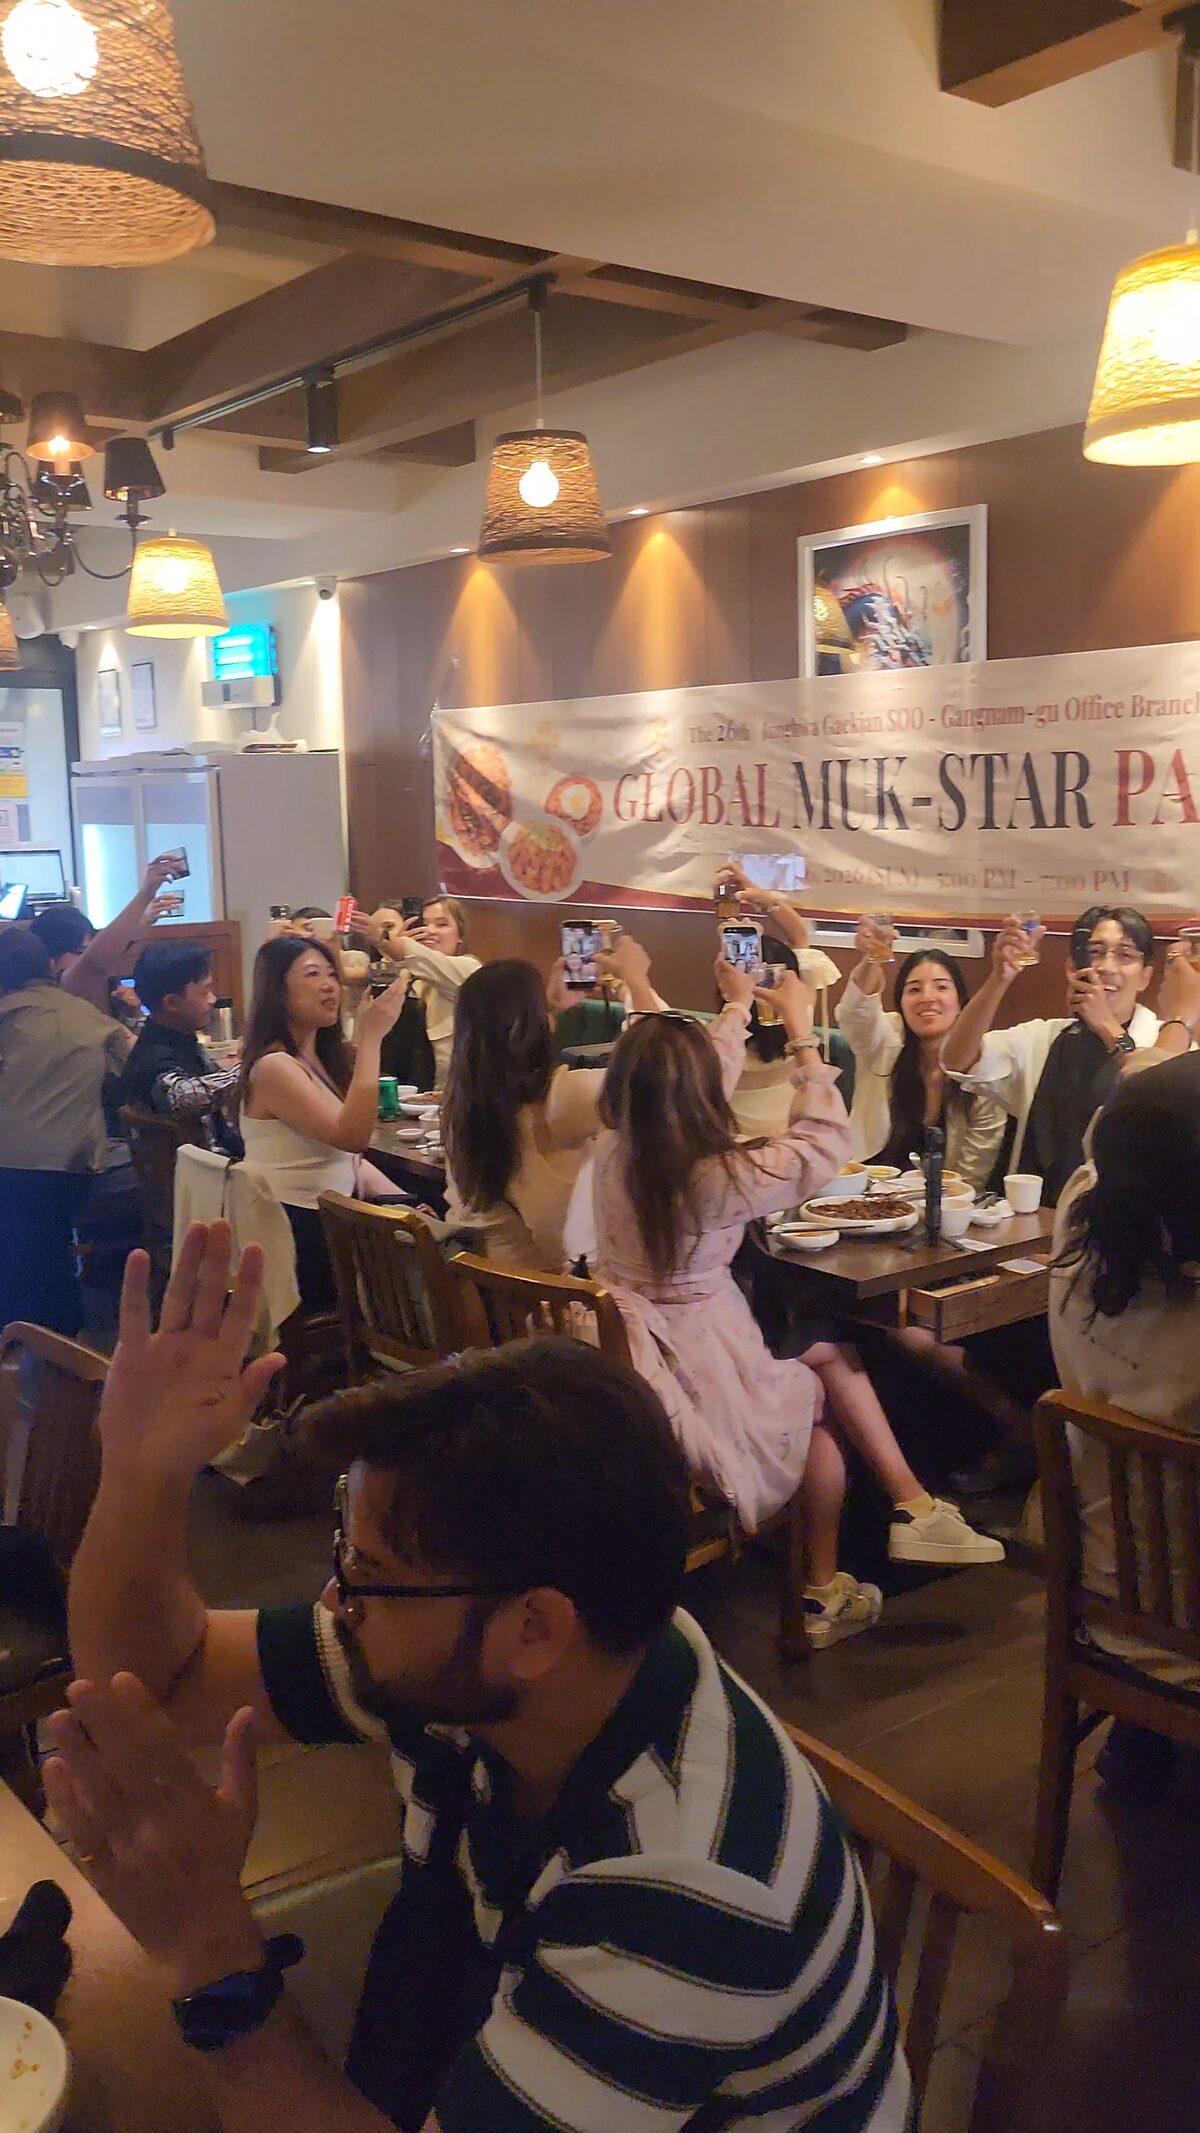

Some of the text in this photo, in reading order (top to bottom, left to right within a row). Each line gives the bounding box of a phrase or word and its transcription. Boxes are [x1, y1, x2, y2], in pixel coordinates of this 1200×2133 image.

[688, 724, 713, 743] The
[887, 706, 925, 732] SOO
[940, 703, 1060, 732] Gangnam-gu
[1065, 694, 1125, 721] Office
[612, 763, 780, 829] GLOBAL
[791, 750, 1096, 832] MUK-STAR
[982, 867, 1017, 890] PM
[1092, 869, 1130, 892] PM
